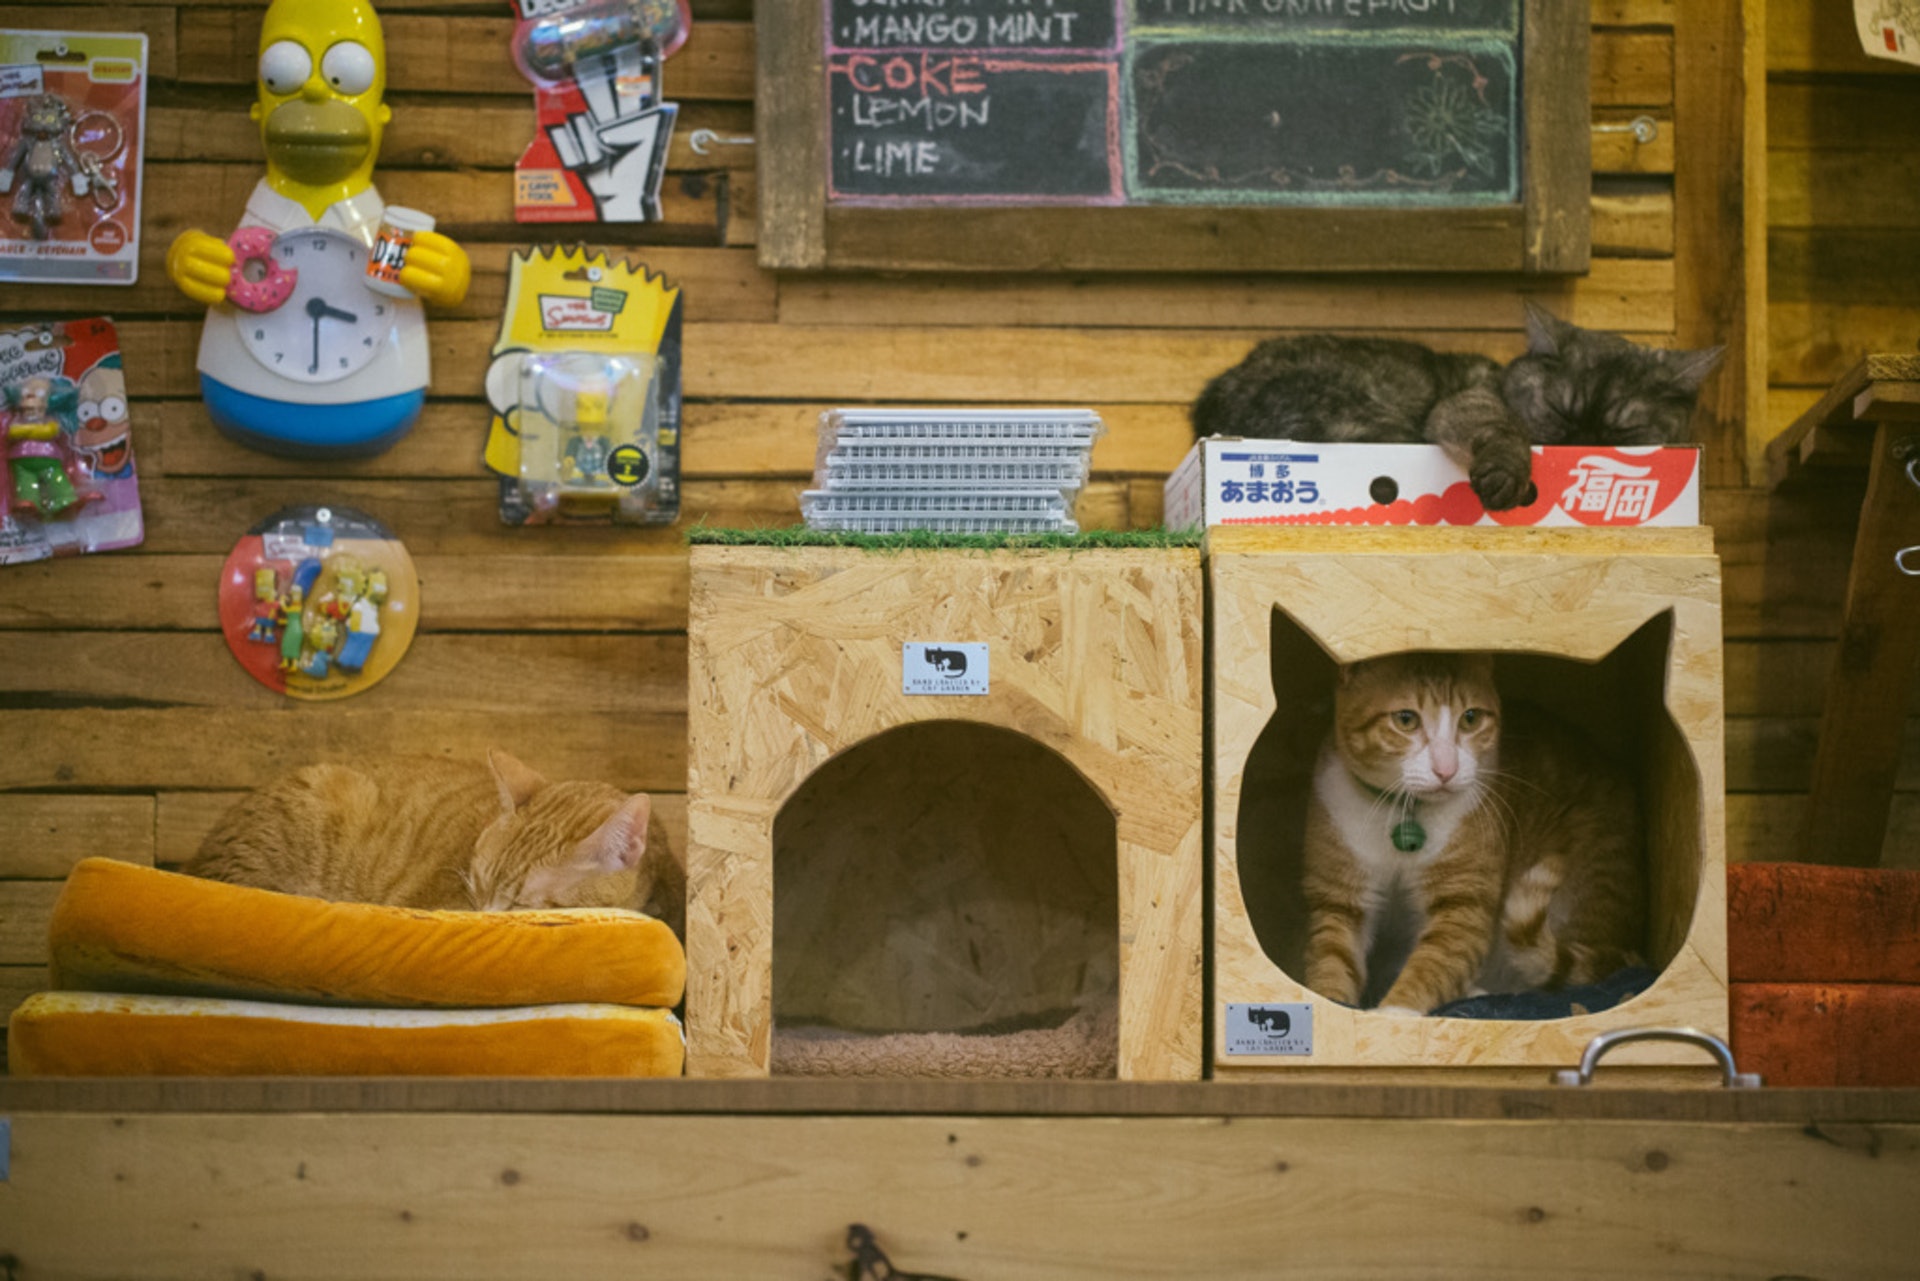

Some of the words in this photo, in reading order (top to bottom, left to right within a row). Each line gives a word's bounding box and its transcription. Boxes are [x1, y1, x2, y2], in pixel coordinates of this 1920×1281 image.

[853, 13, 978, 46] MANGO
[987, 10, 1079, 46] MINT
[848, 50, 988, 97] COKE
[853, 92, 992, 131] LEMON
[853, 140, 941, 177] LIME
[312, 239, 327, 251] 12
[283, 247, 294, 258] 11
[375, 304, 385, 316] 3
[254, 329, 265, 341] 8
[363, 336, 373, 348] 4
[274, 352, 285, 364] 7
[339, 357, 349, 369] 5
[1249, 463, 1290, 479] 博多
[1220, 479, 1320, 504] あまおう
[1560, 454, 1660, 522] 福岡
